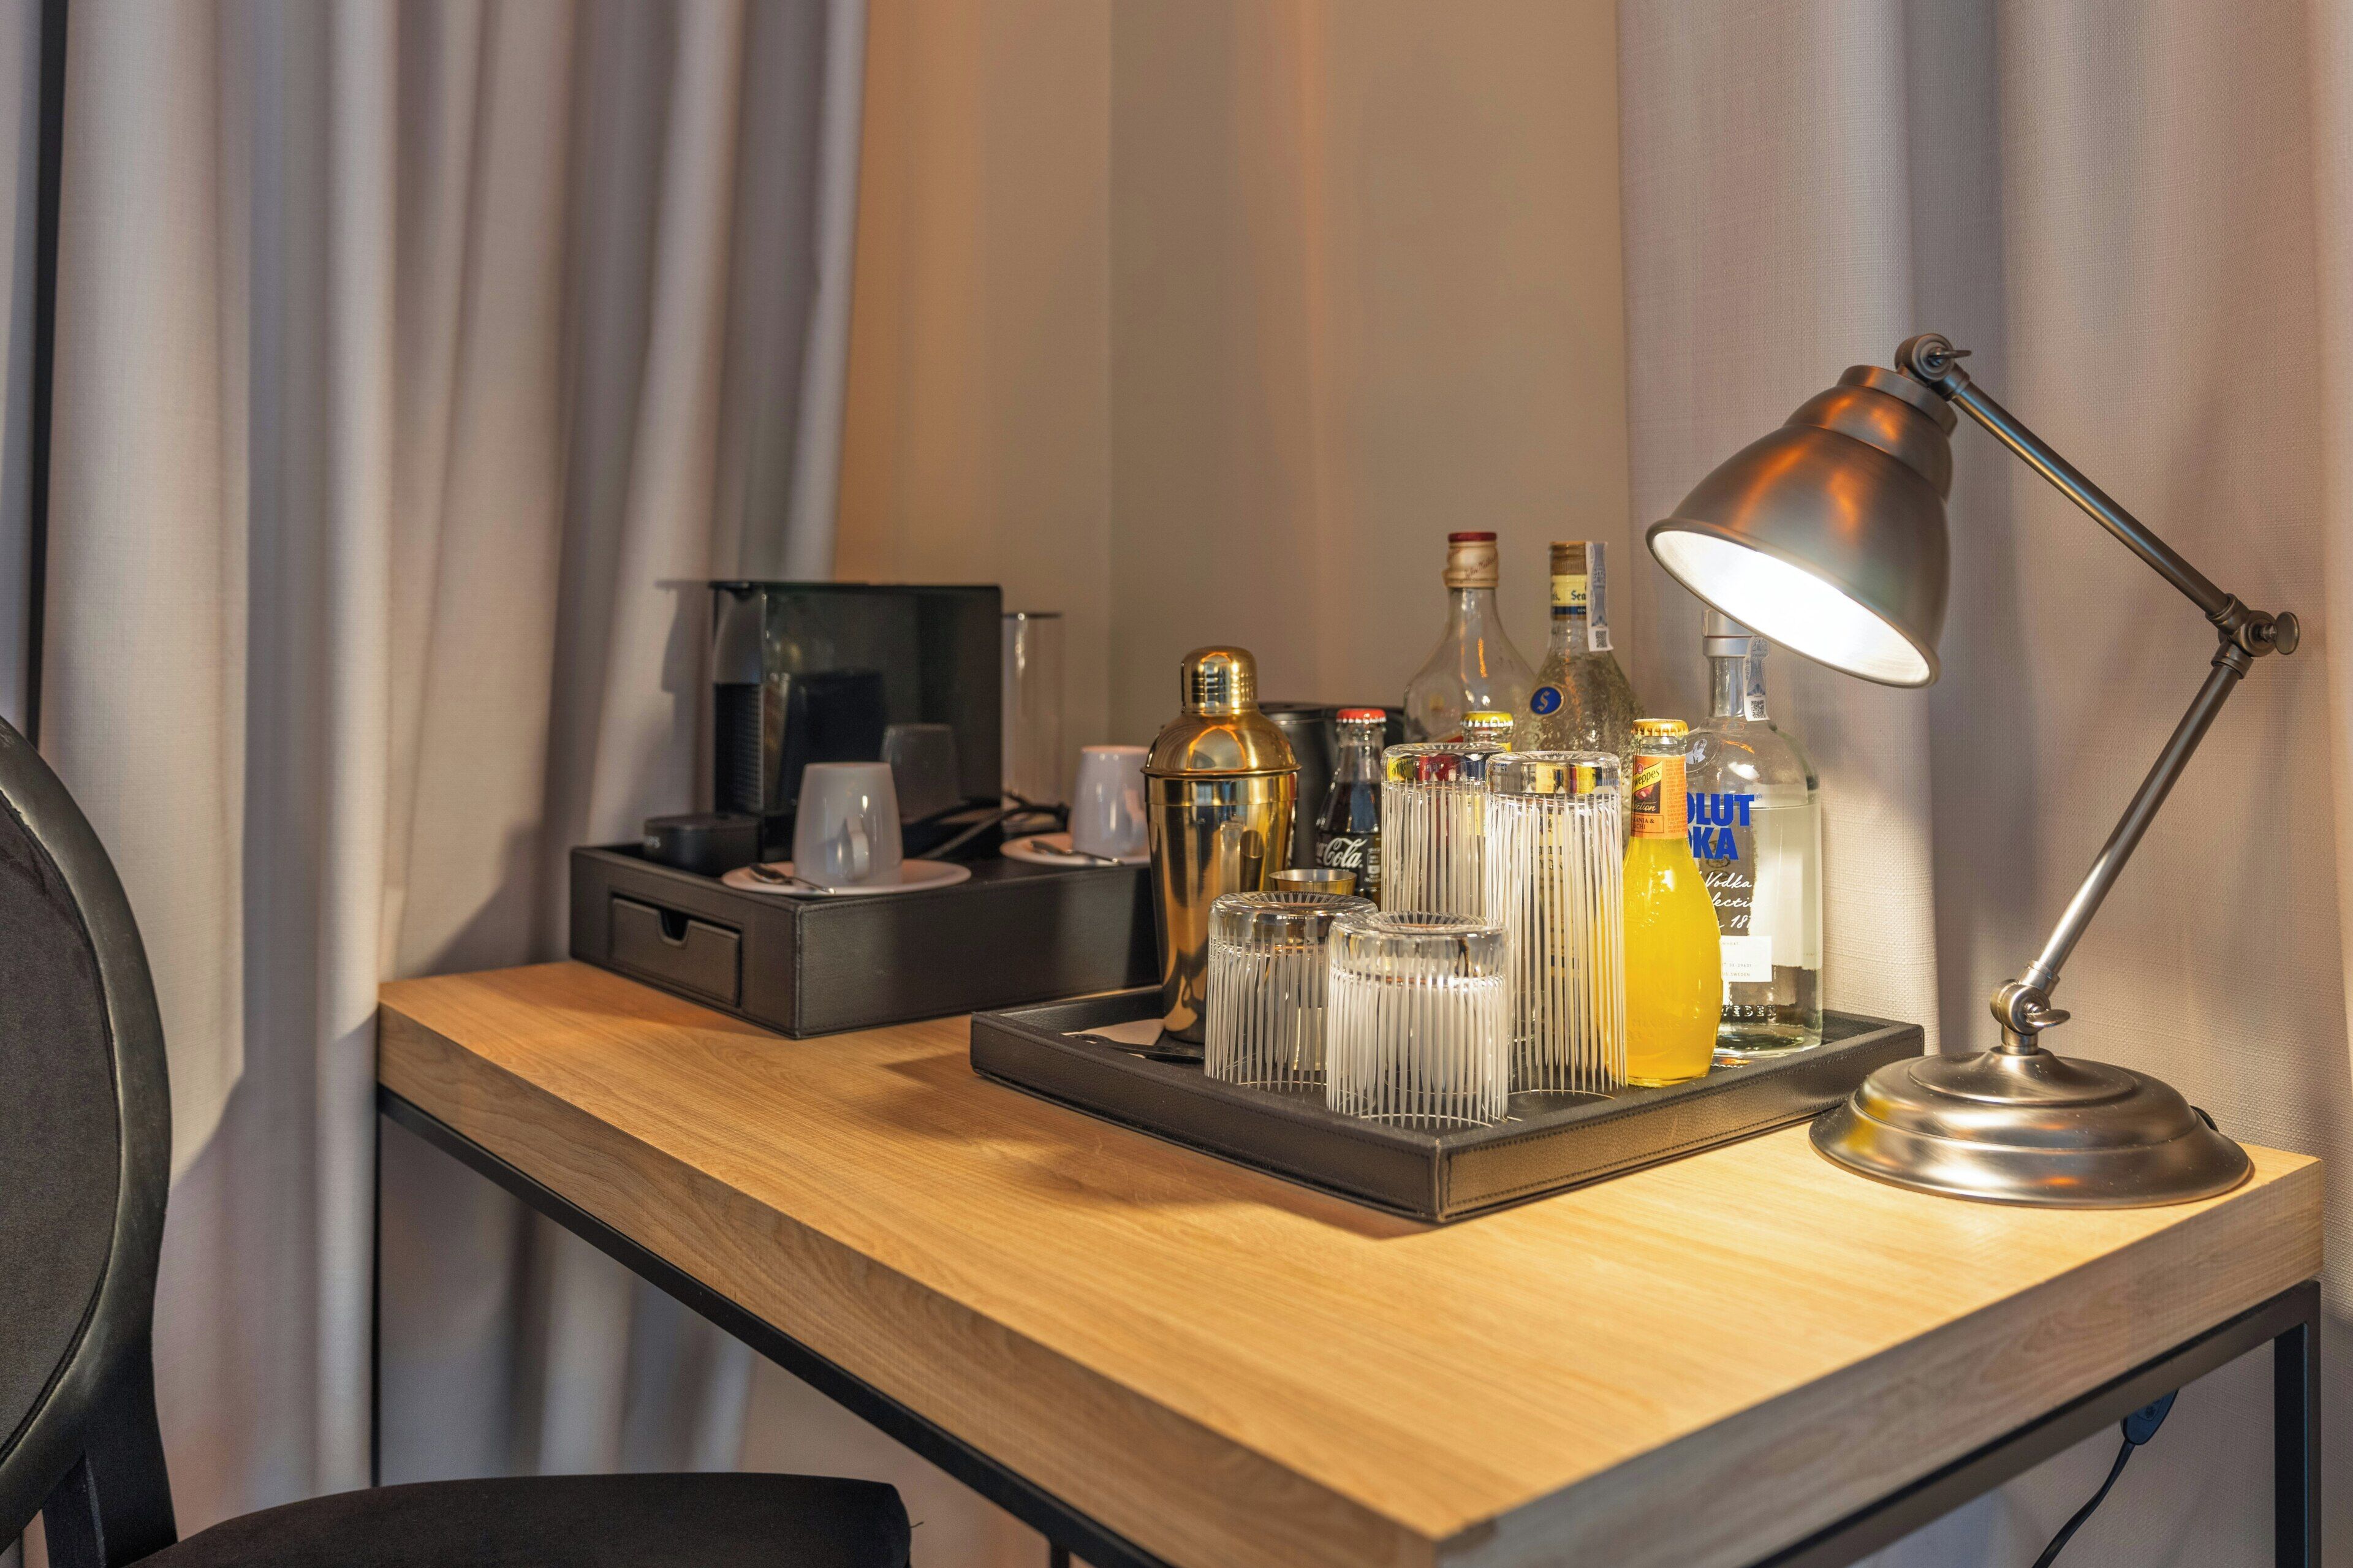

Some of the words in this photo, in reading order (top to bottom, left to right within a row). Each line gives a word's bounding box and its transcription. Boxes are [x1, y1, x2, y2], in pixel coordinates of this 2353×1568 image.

[1324, 837, 1368, 868] Cola
[1705, 871, 1752, 888] Vodka
[1712, 892, 1753, 907] lecti
